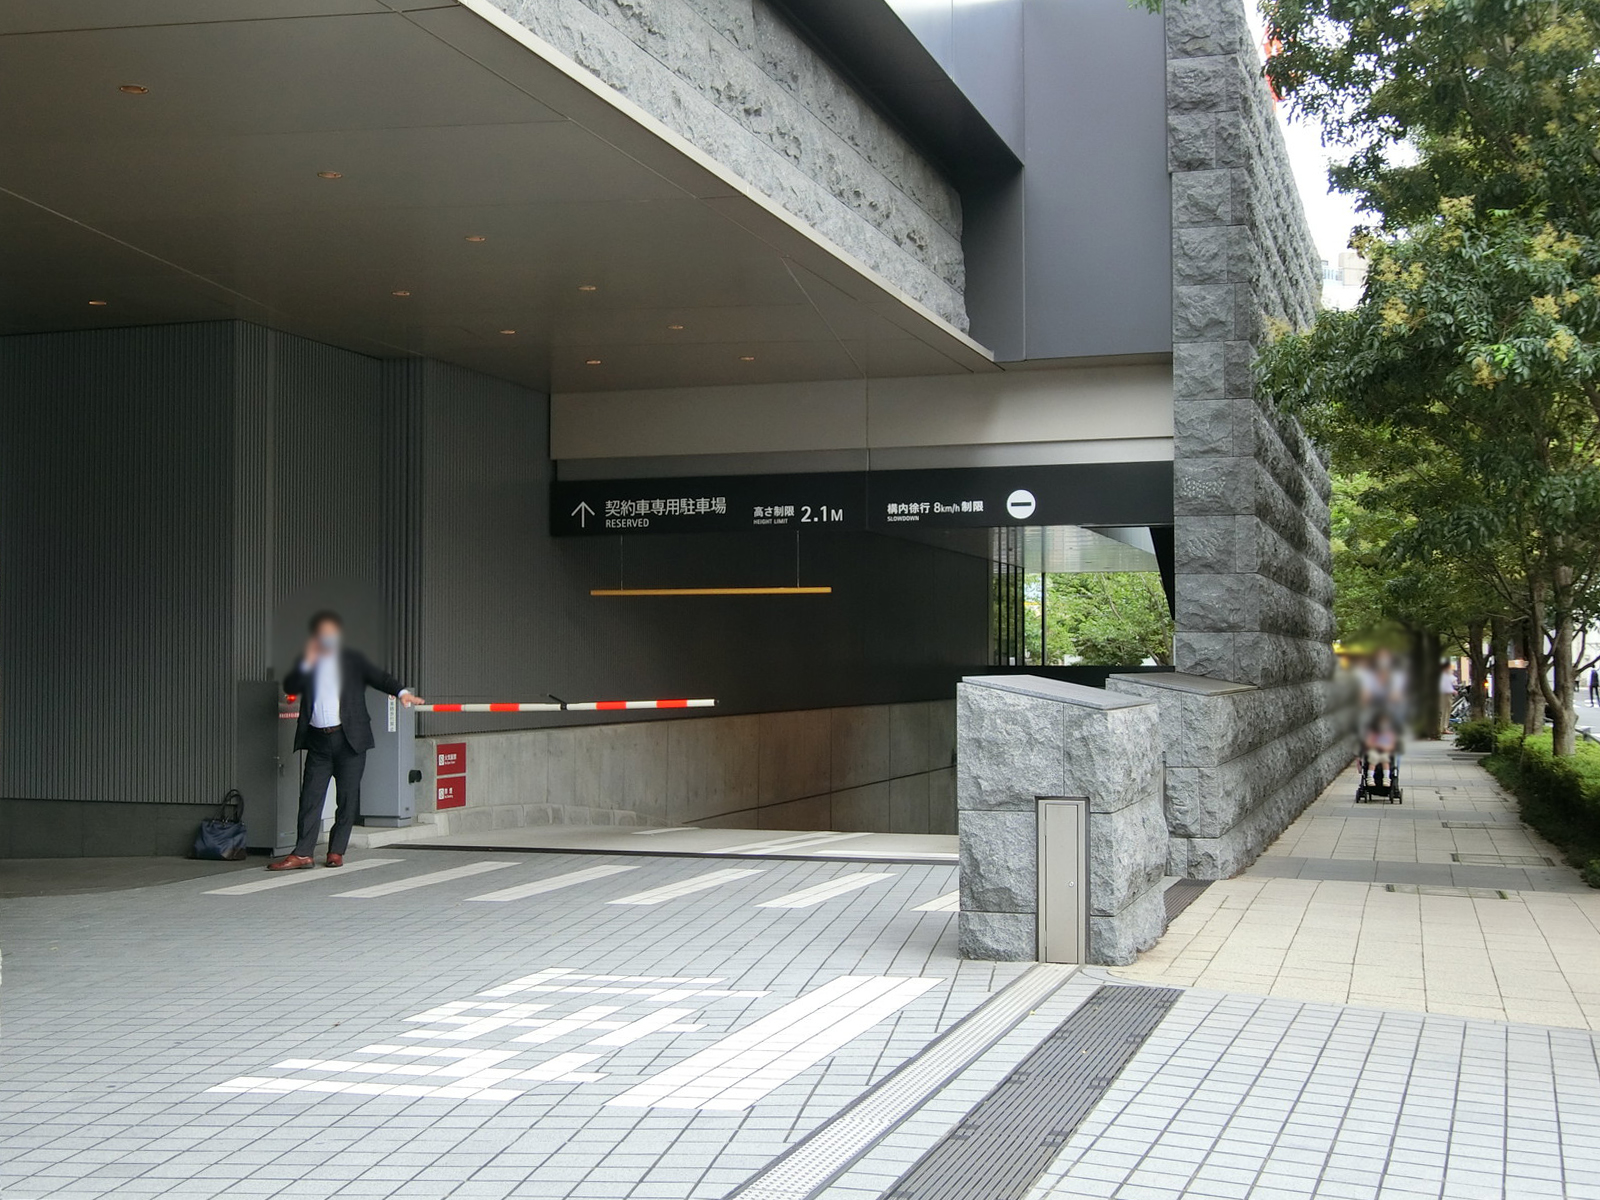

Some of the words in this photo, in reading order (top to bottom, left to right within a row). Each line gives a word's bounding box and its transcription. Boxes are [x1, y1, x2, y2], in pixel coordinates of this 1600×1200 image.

[605, 497, 727, 518] 契約車専用駐車場
[753, 505, 795, 518] 高さ制限
[887, 502, 930, 514] 構内徐行
[605, 518, 650, 528] RESERVED
